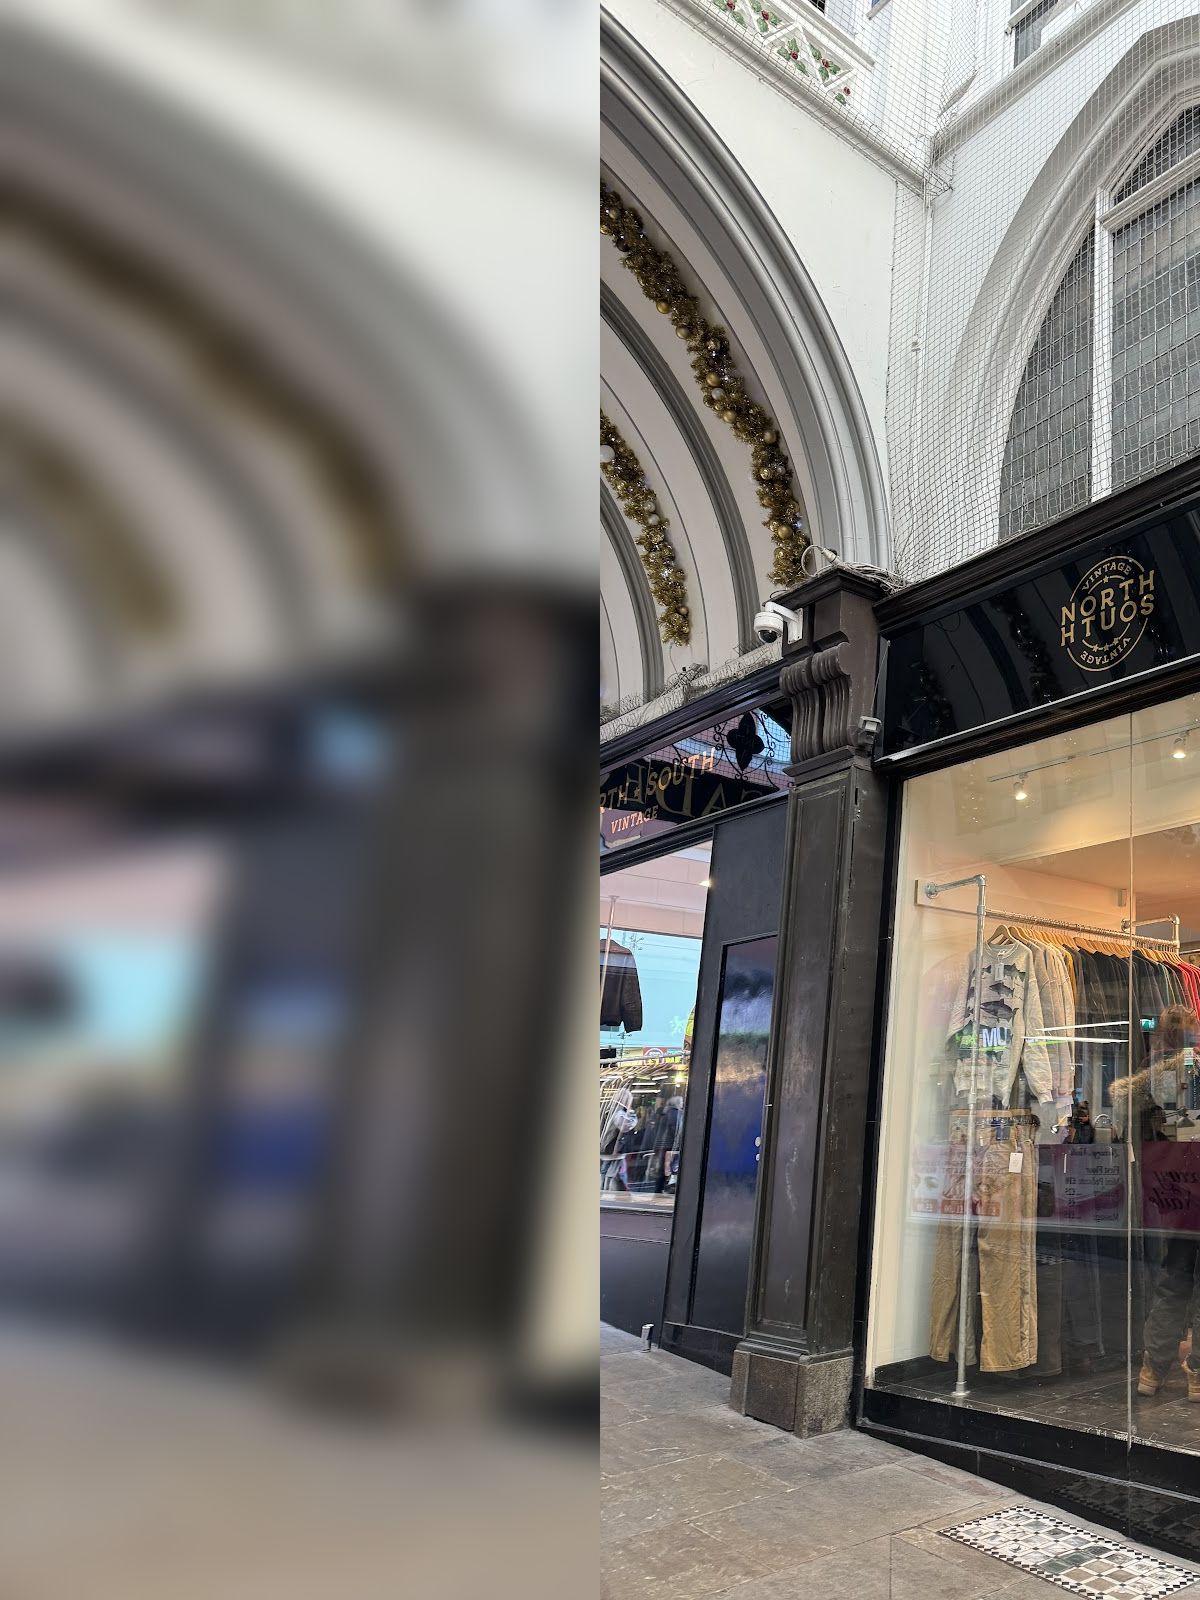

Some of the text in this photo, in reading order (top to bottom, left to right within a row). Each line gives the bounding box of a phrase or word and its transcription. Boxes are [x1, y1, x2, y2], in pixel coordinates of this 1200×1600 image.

[1081, 561, 1132, 590] VINTAGE
[1061, 569, 1155, 626] NORTH
[1080, 637, 1131, 666] VINTAGE
[643, 746, 716, 796] SOUTH
[610, 804, 659, 834] VINTAGE
